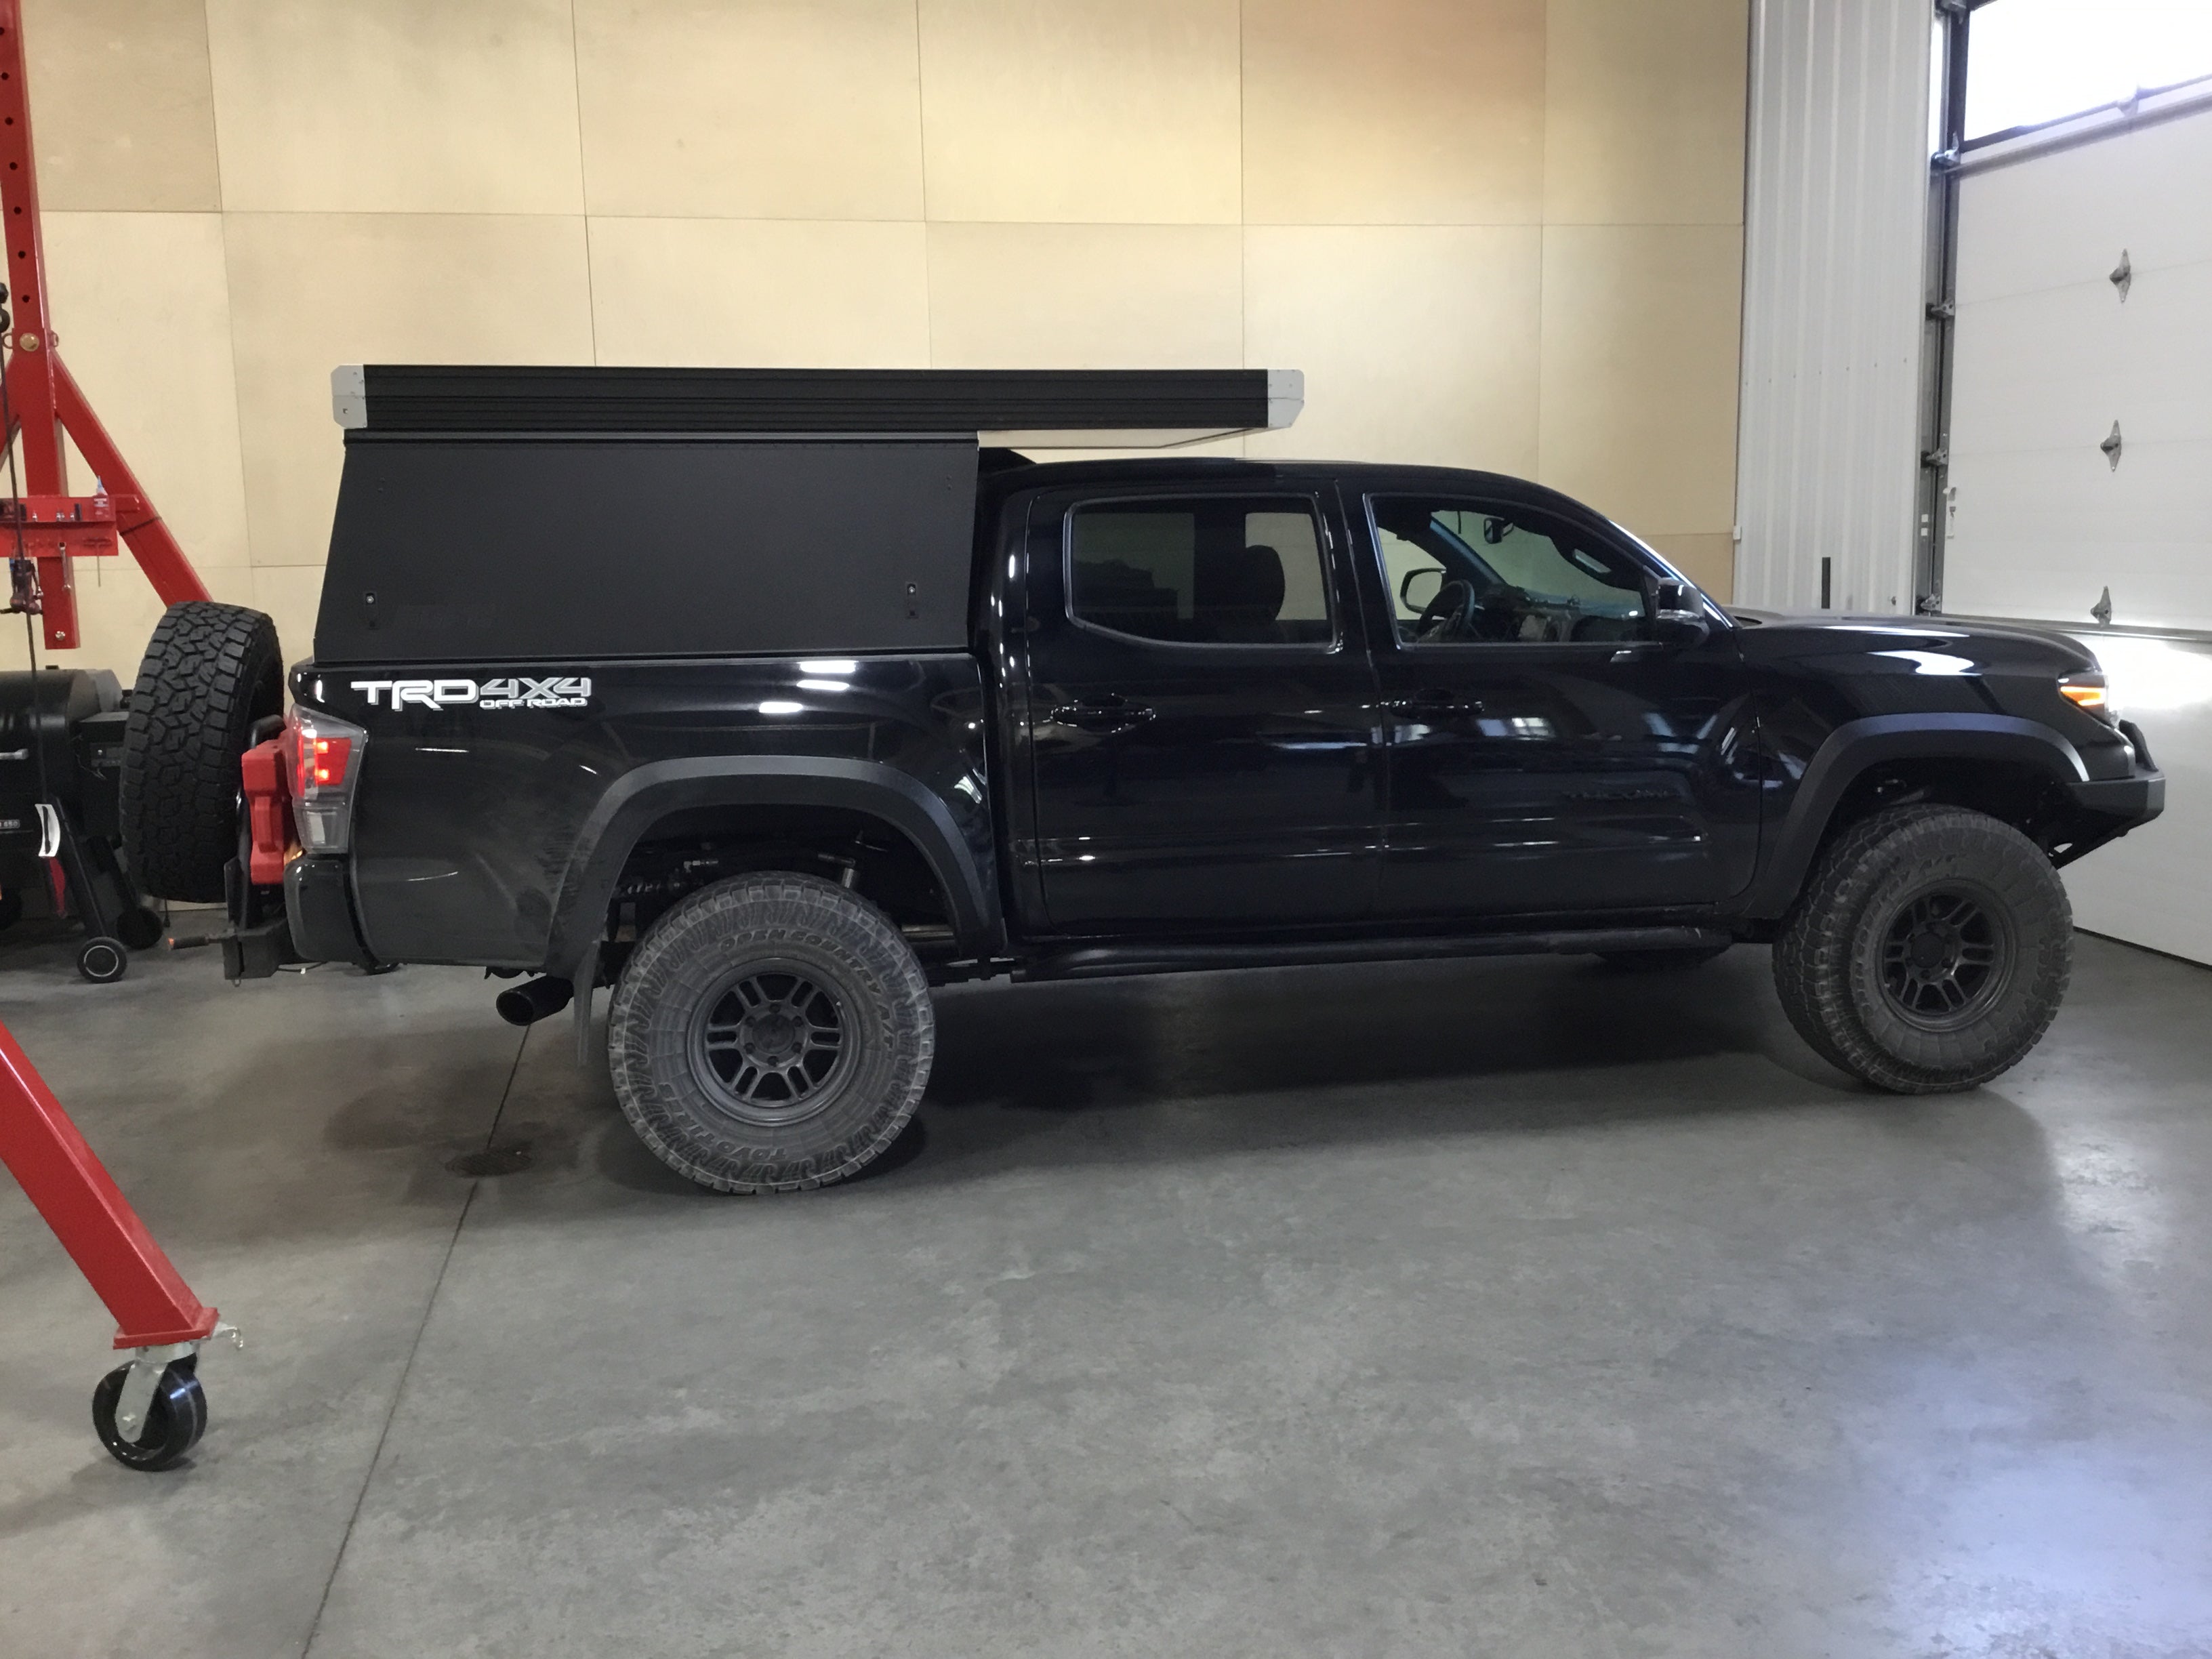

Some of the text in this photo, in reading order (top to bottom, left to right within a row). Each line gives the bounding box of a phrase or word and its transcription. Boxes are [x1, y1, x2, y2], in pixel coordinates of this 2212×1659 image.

[350, 679, 479, 712] TRD
[480, 697, 588, 710] OFF ROAD
[720, 929, 786, 949] OPEN
[790, 931, 882, 994] COUNTRY
[658, 1083, 786, 1160] TOYO TIRES
